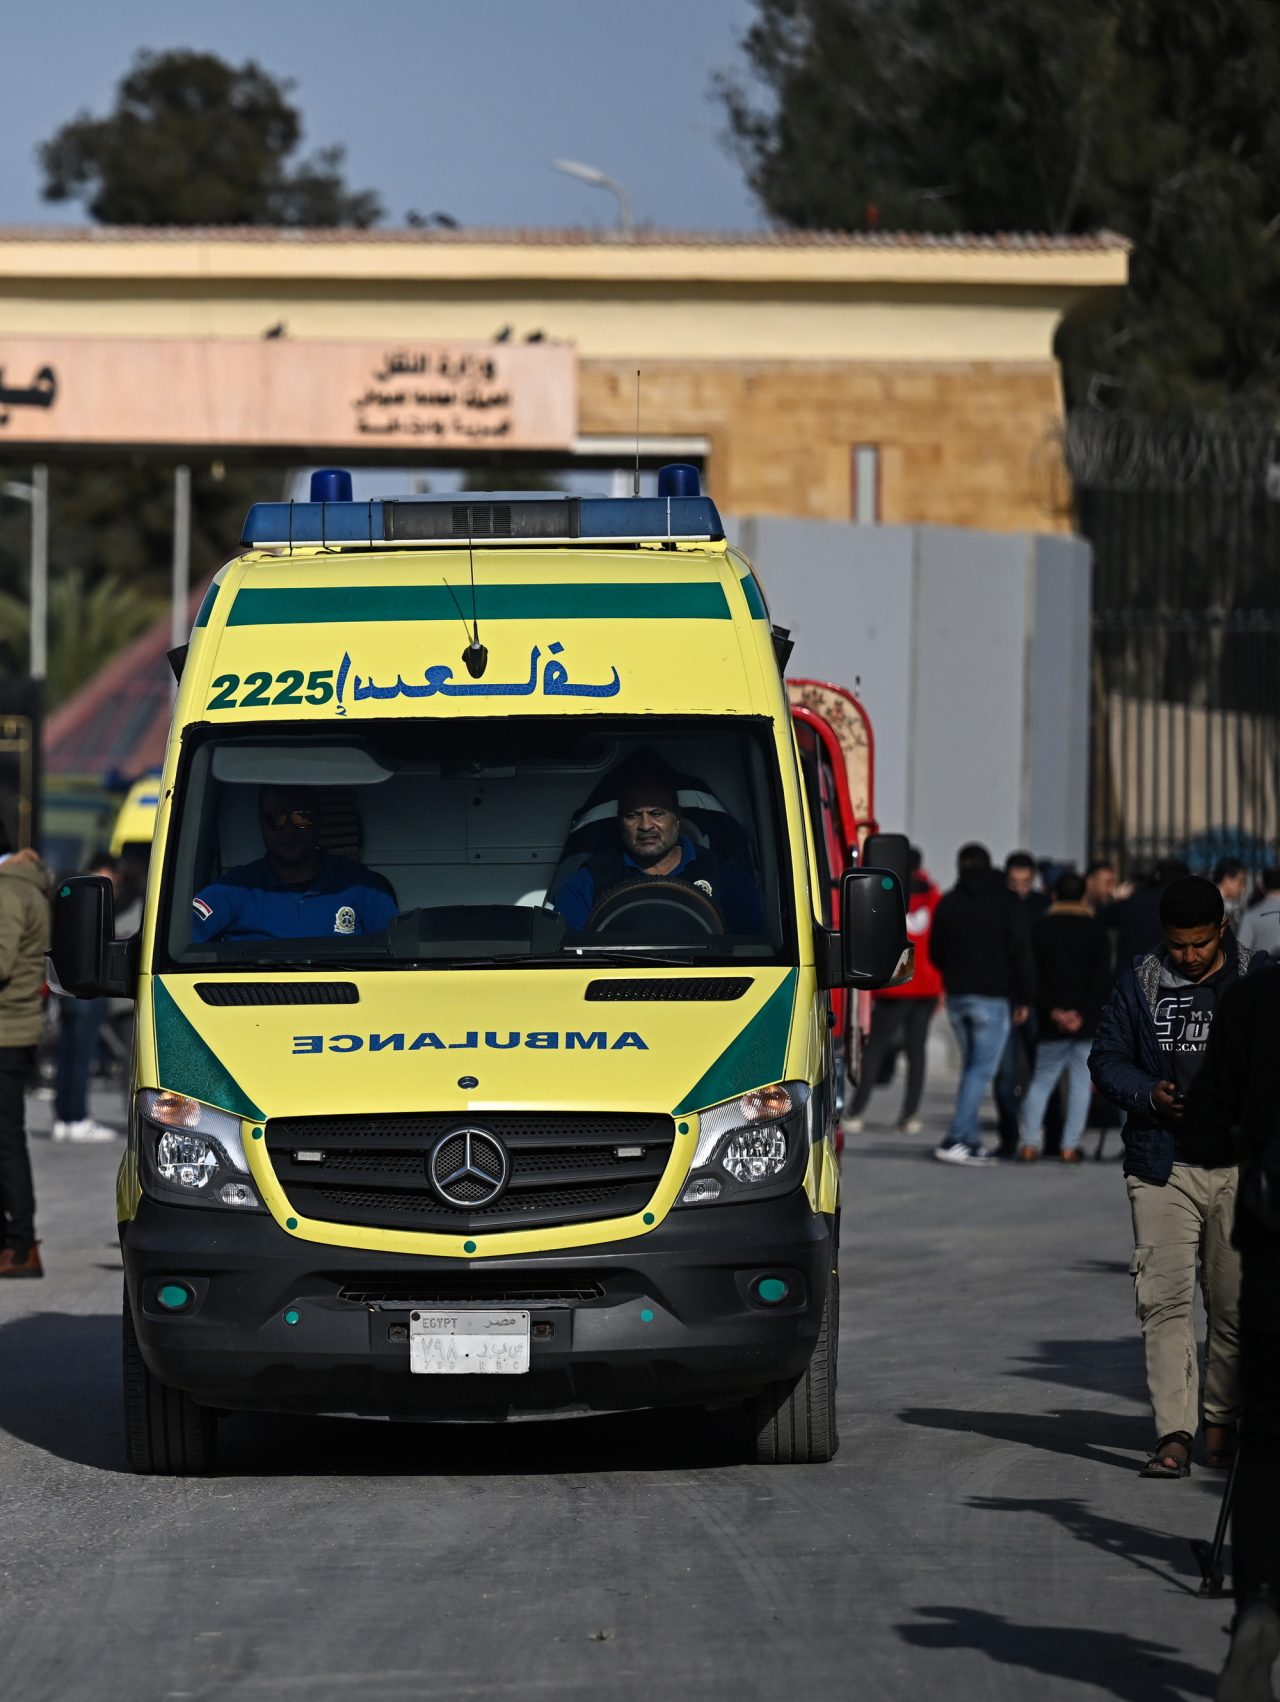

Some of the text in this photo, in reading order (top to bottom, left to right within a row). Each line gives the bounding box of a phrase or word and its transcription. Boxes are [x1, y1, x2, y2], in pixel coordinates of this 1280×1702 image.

[205, 669, 334, 711] 2225
[422, 1318, 459, 1329] EGYPT
[483, 1318, 516, 1329] مصر
